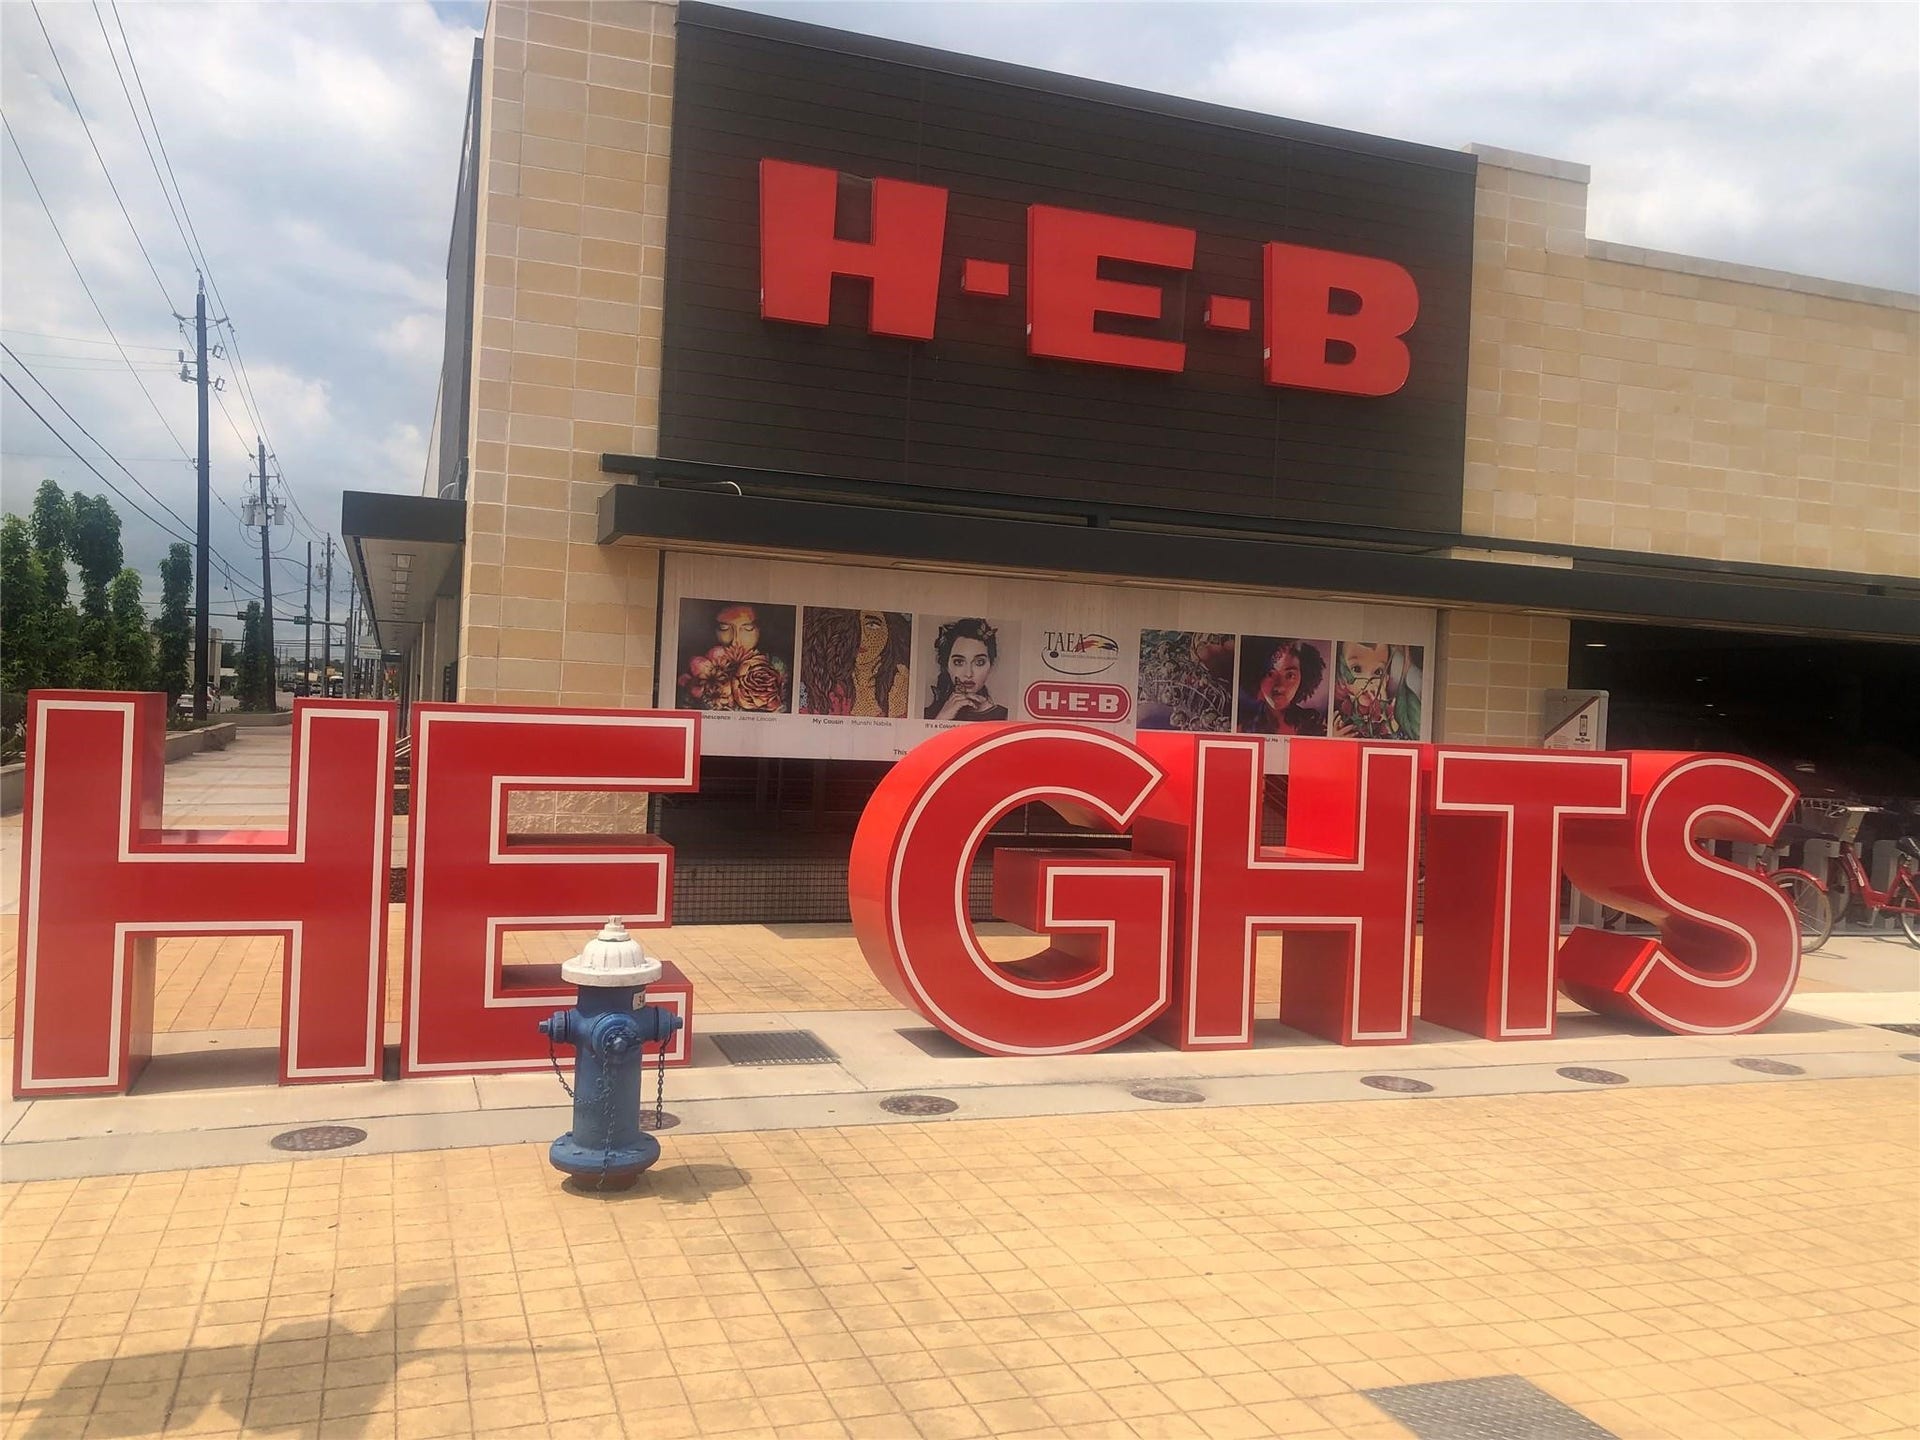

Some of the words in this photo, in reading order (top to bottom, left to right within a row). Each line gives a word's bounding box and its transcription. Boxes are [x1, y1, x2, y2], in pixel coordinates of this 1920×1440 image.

[758, 158, 1420, 396] H-E-B
[1044, 631, 1086, 653] TAEA
[1038, 690, 1120, 713] H-E-B
[812, 717, 822, 725] My
[850, 722, 1801, 1056] GHTS
